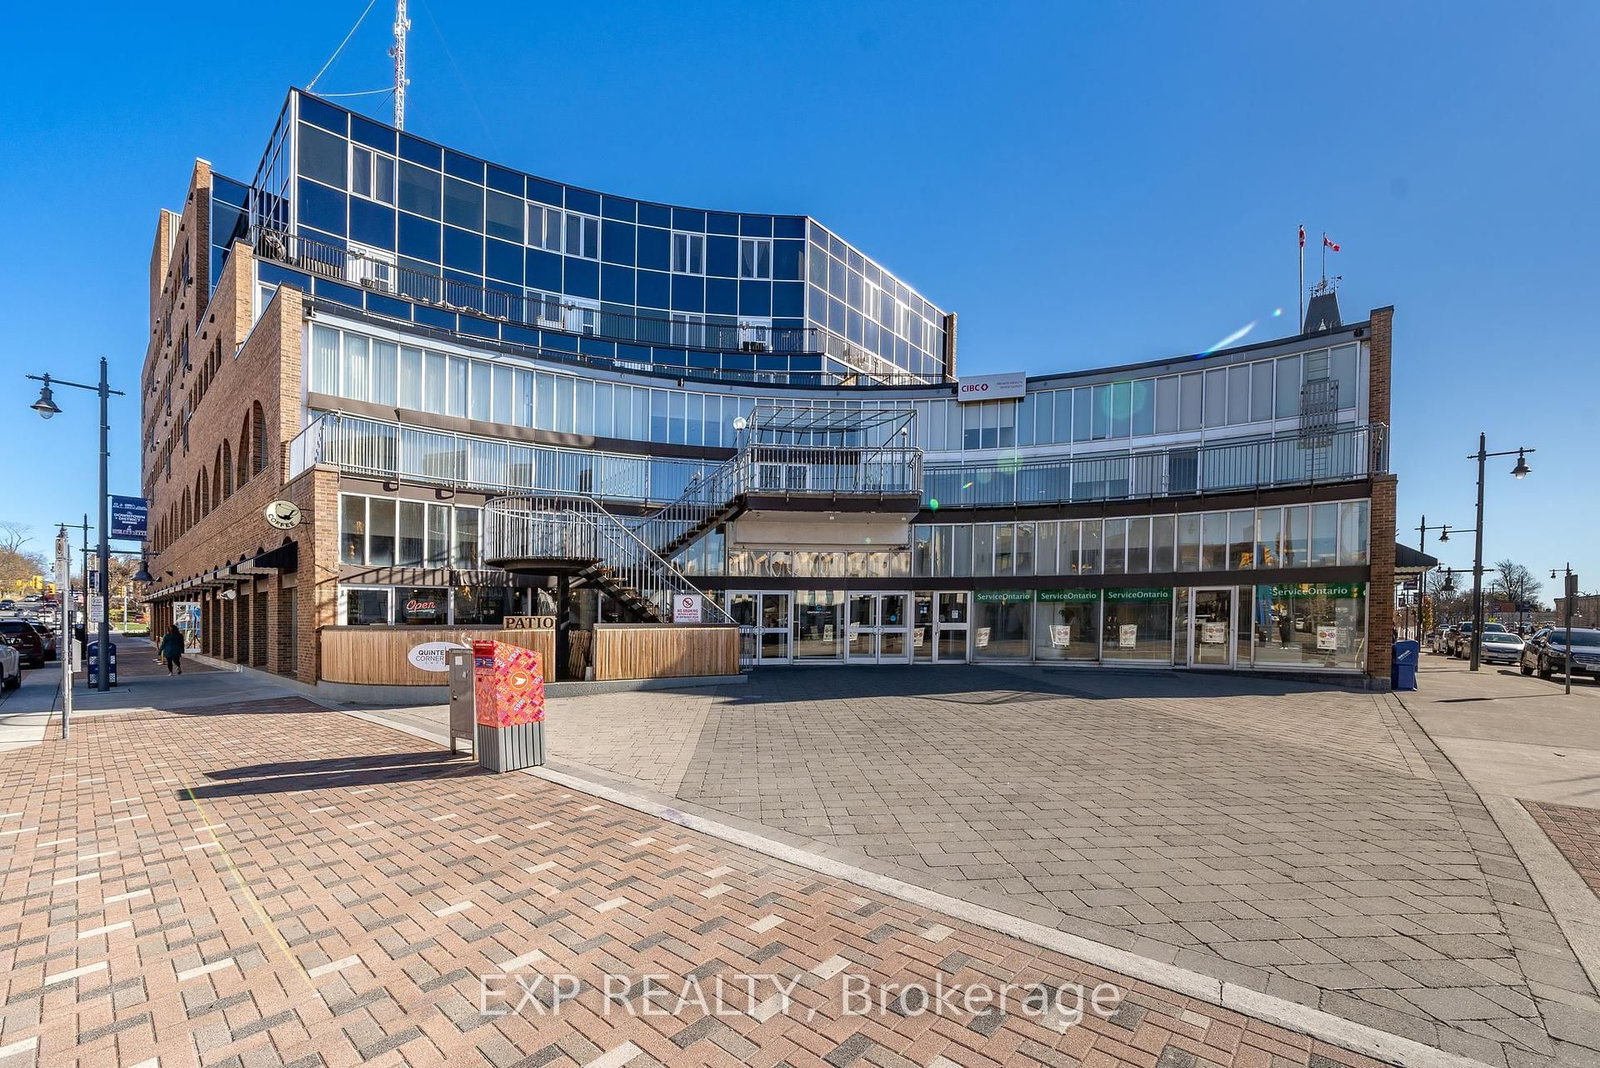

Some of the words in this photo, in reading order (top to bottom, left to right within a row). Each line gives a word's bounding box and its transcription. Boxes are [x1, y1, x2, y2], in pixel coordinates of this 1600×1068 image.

[961, 384, 980, 393] CIBC
[268, 513, 295, 528] COFFEE
[1041, 592, 1097, 600] ServiceOntario
[1272, 586, 1348, 597] ServiceOntario
[406, 600, 436, 612] Open
[505, 617, 554, 629] PATIO
